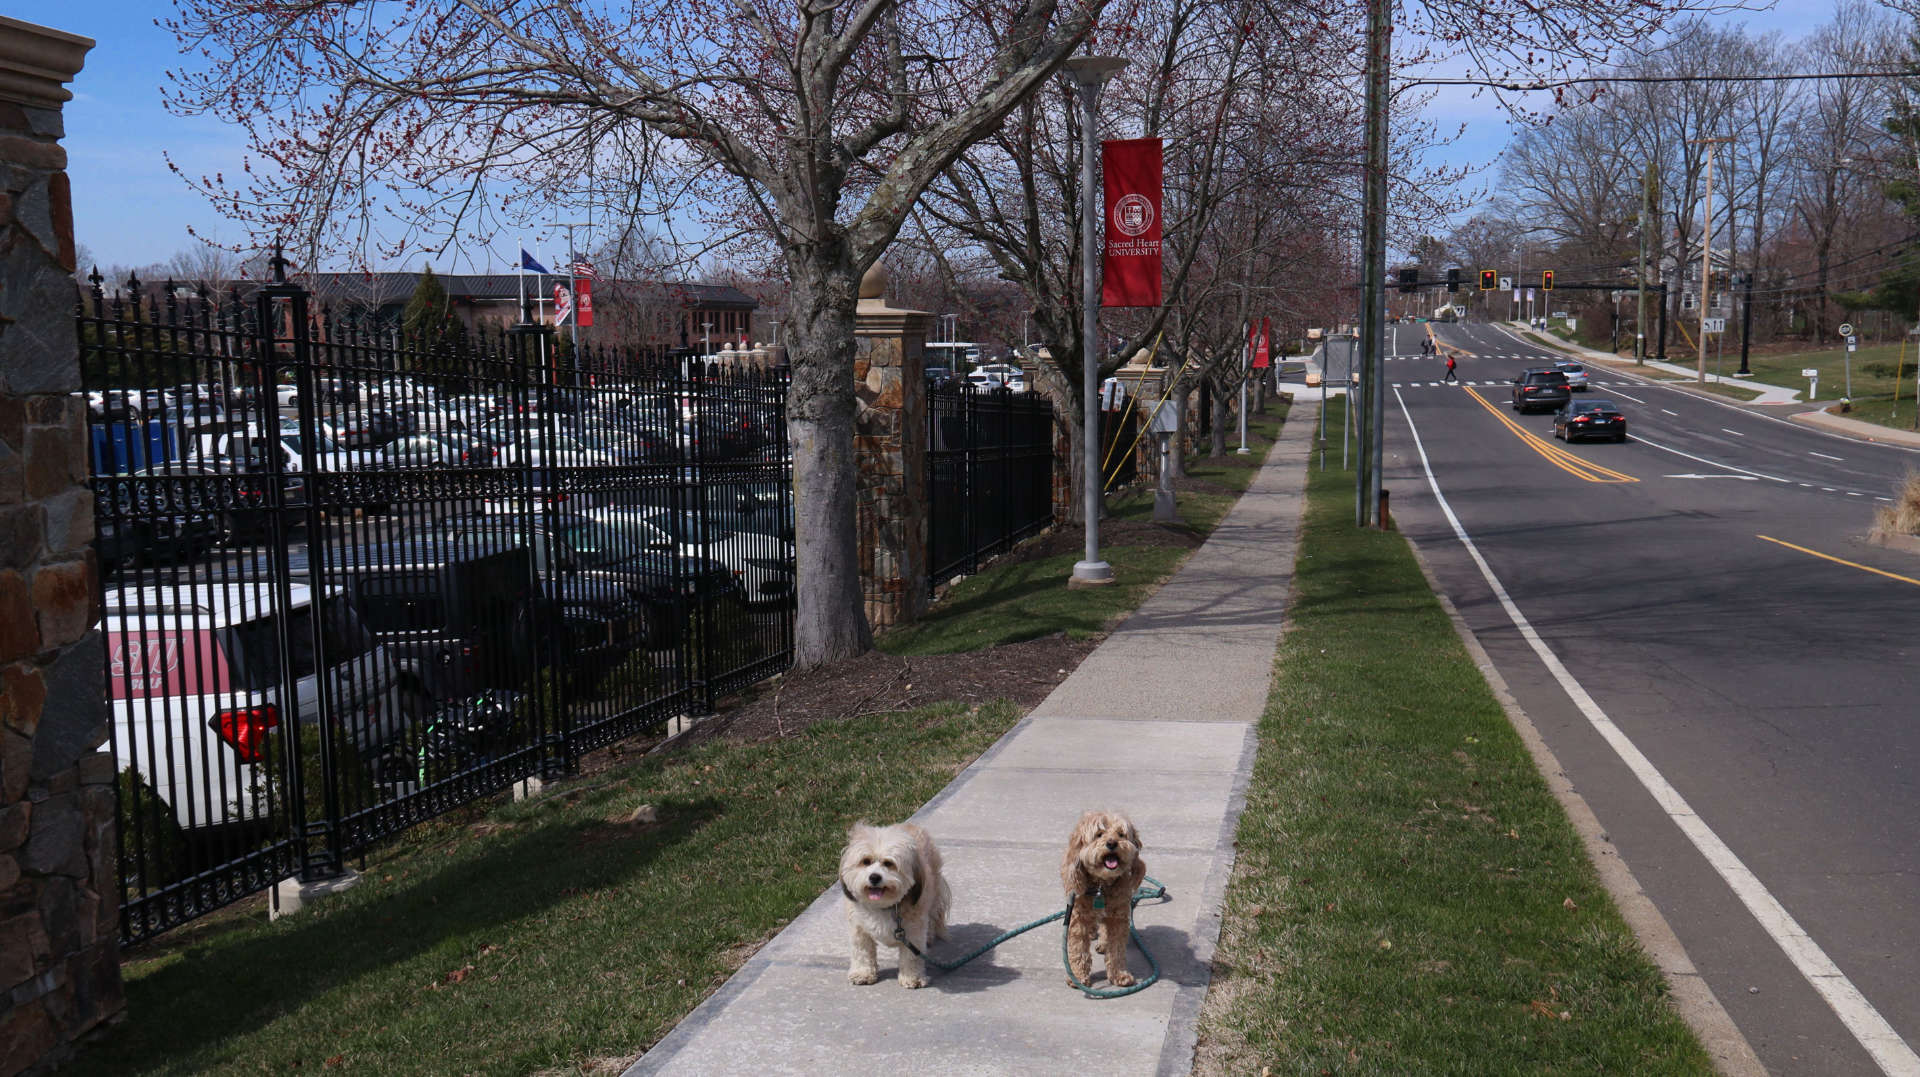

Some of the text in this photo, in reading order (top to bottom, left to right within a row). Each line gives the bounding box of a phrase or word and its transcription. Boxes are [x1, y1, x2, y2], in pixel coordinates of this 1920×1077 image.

[1109, 238, 1159, 248] Sacred Heart
[1109, 247, 1159, 256] UNIVERSITY
